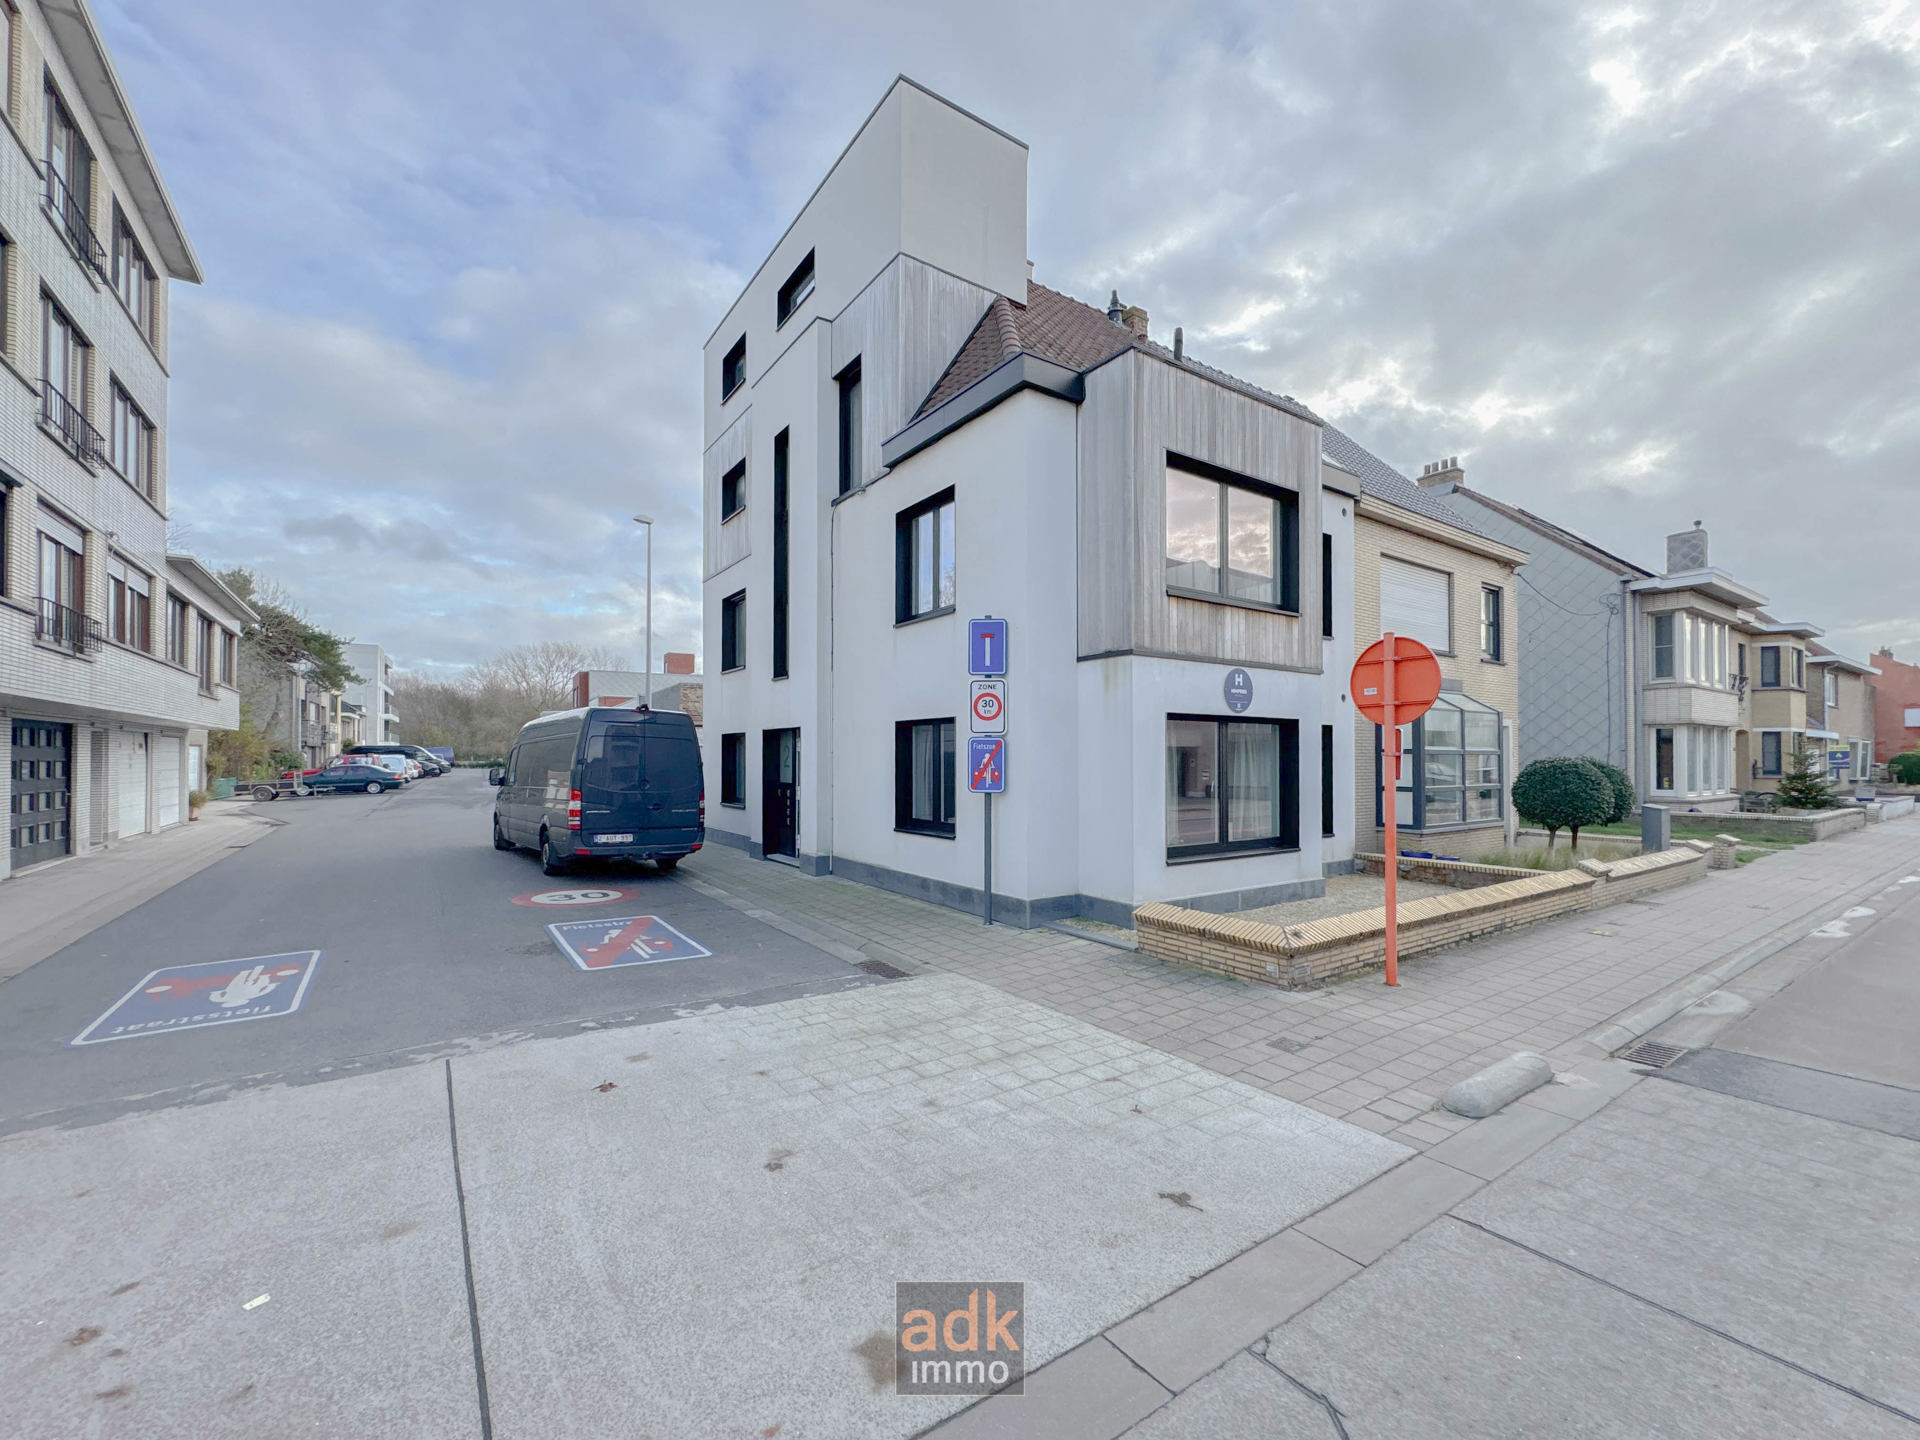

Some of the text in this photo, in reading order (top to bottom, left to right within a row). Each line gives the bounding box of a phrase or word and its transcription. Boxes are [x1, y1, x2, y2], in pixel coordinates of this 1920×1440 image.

[1235, 673, 1243, 686] H
[981, 699, 994, 708] 30
[783, 745, 790, 768] 2
[546, 891, 610, 901] 30
